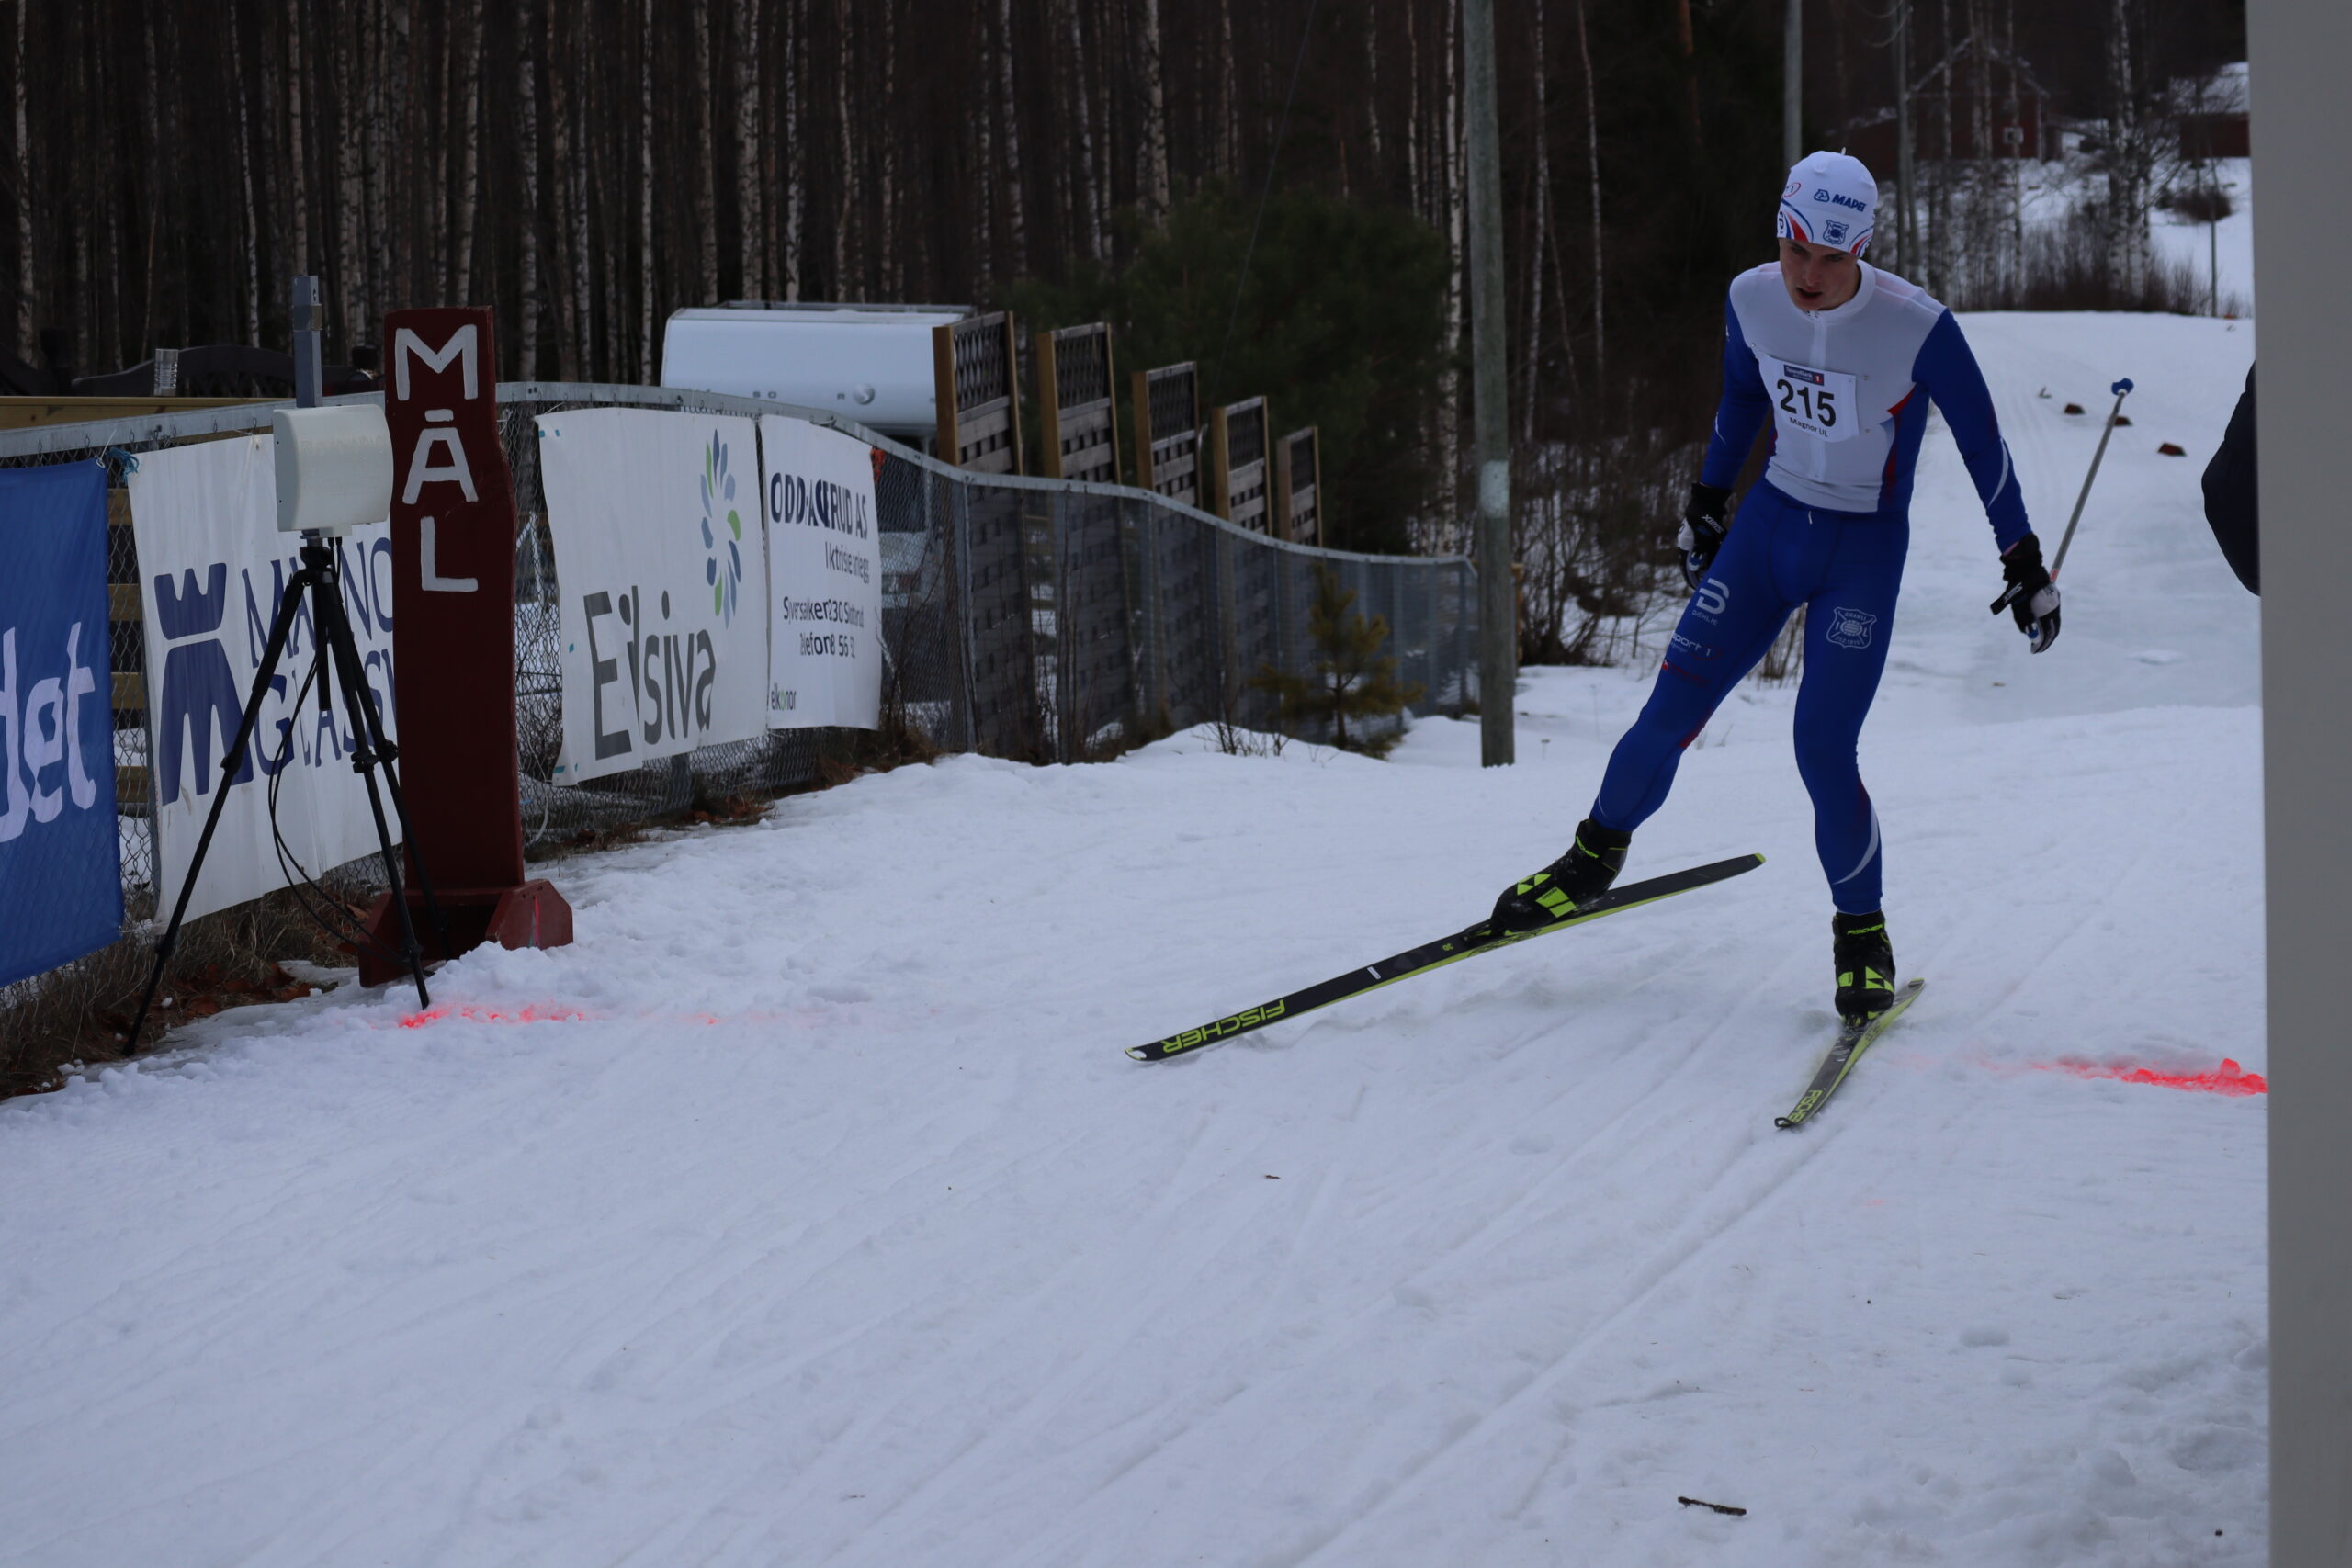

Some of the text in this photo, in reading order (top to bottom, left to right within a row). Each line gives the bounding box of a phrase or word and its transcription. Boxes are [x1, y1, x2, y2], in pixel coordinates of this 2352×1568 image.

[1831, 194, 1867, 212] MAPEI
[1777, 378, 1837, 427] 215
[394, 323, 480, 593] MÅL
[1160, 999, 1286, 1054] FISCHER
